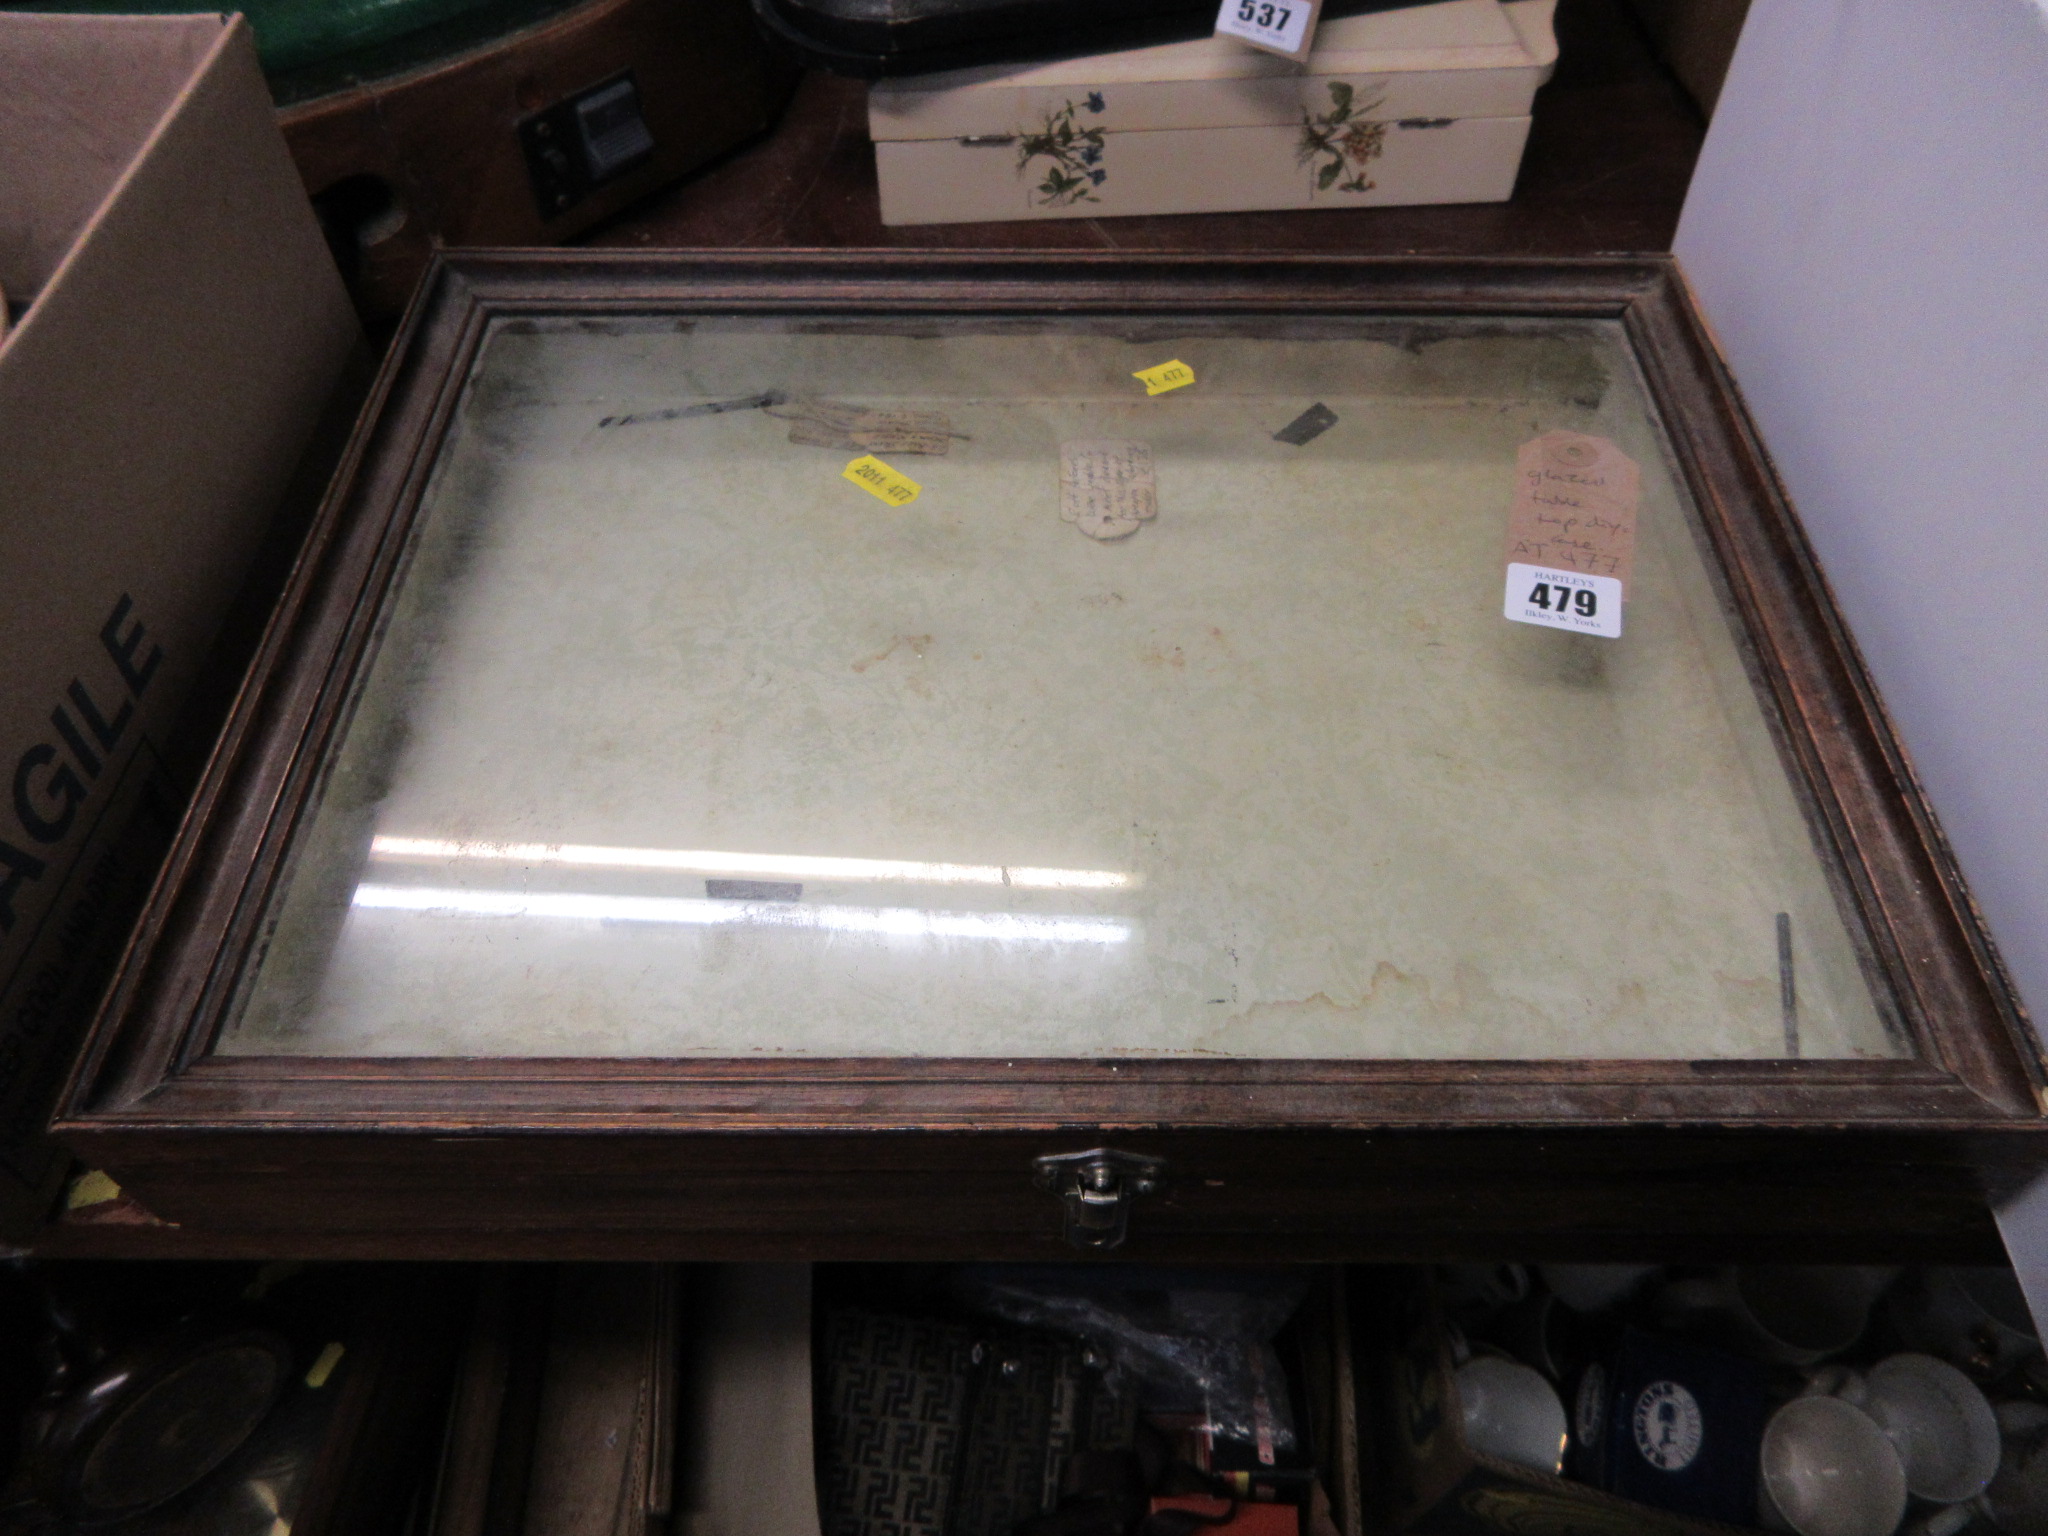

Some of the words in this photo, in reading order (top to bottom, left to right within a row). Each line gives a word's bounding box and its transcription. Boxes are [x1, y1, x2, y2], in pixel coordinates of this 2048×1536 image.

[1238, 0, 1292, 31] 537
[1514, 541, 1550, 559] AT
[1560, 551, 1620, 574] 477
[1534, 571, 1596, 588] HARTLEYS
[1528, 582, 1597, 618] 479
[1574, 617, 1601, 629] Yorks
